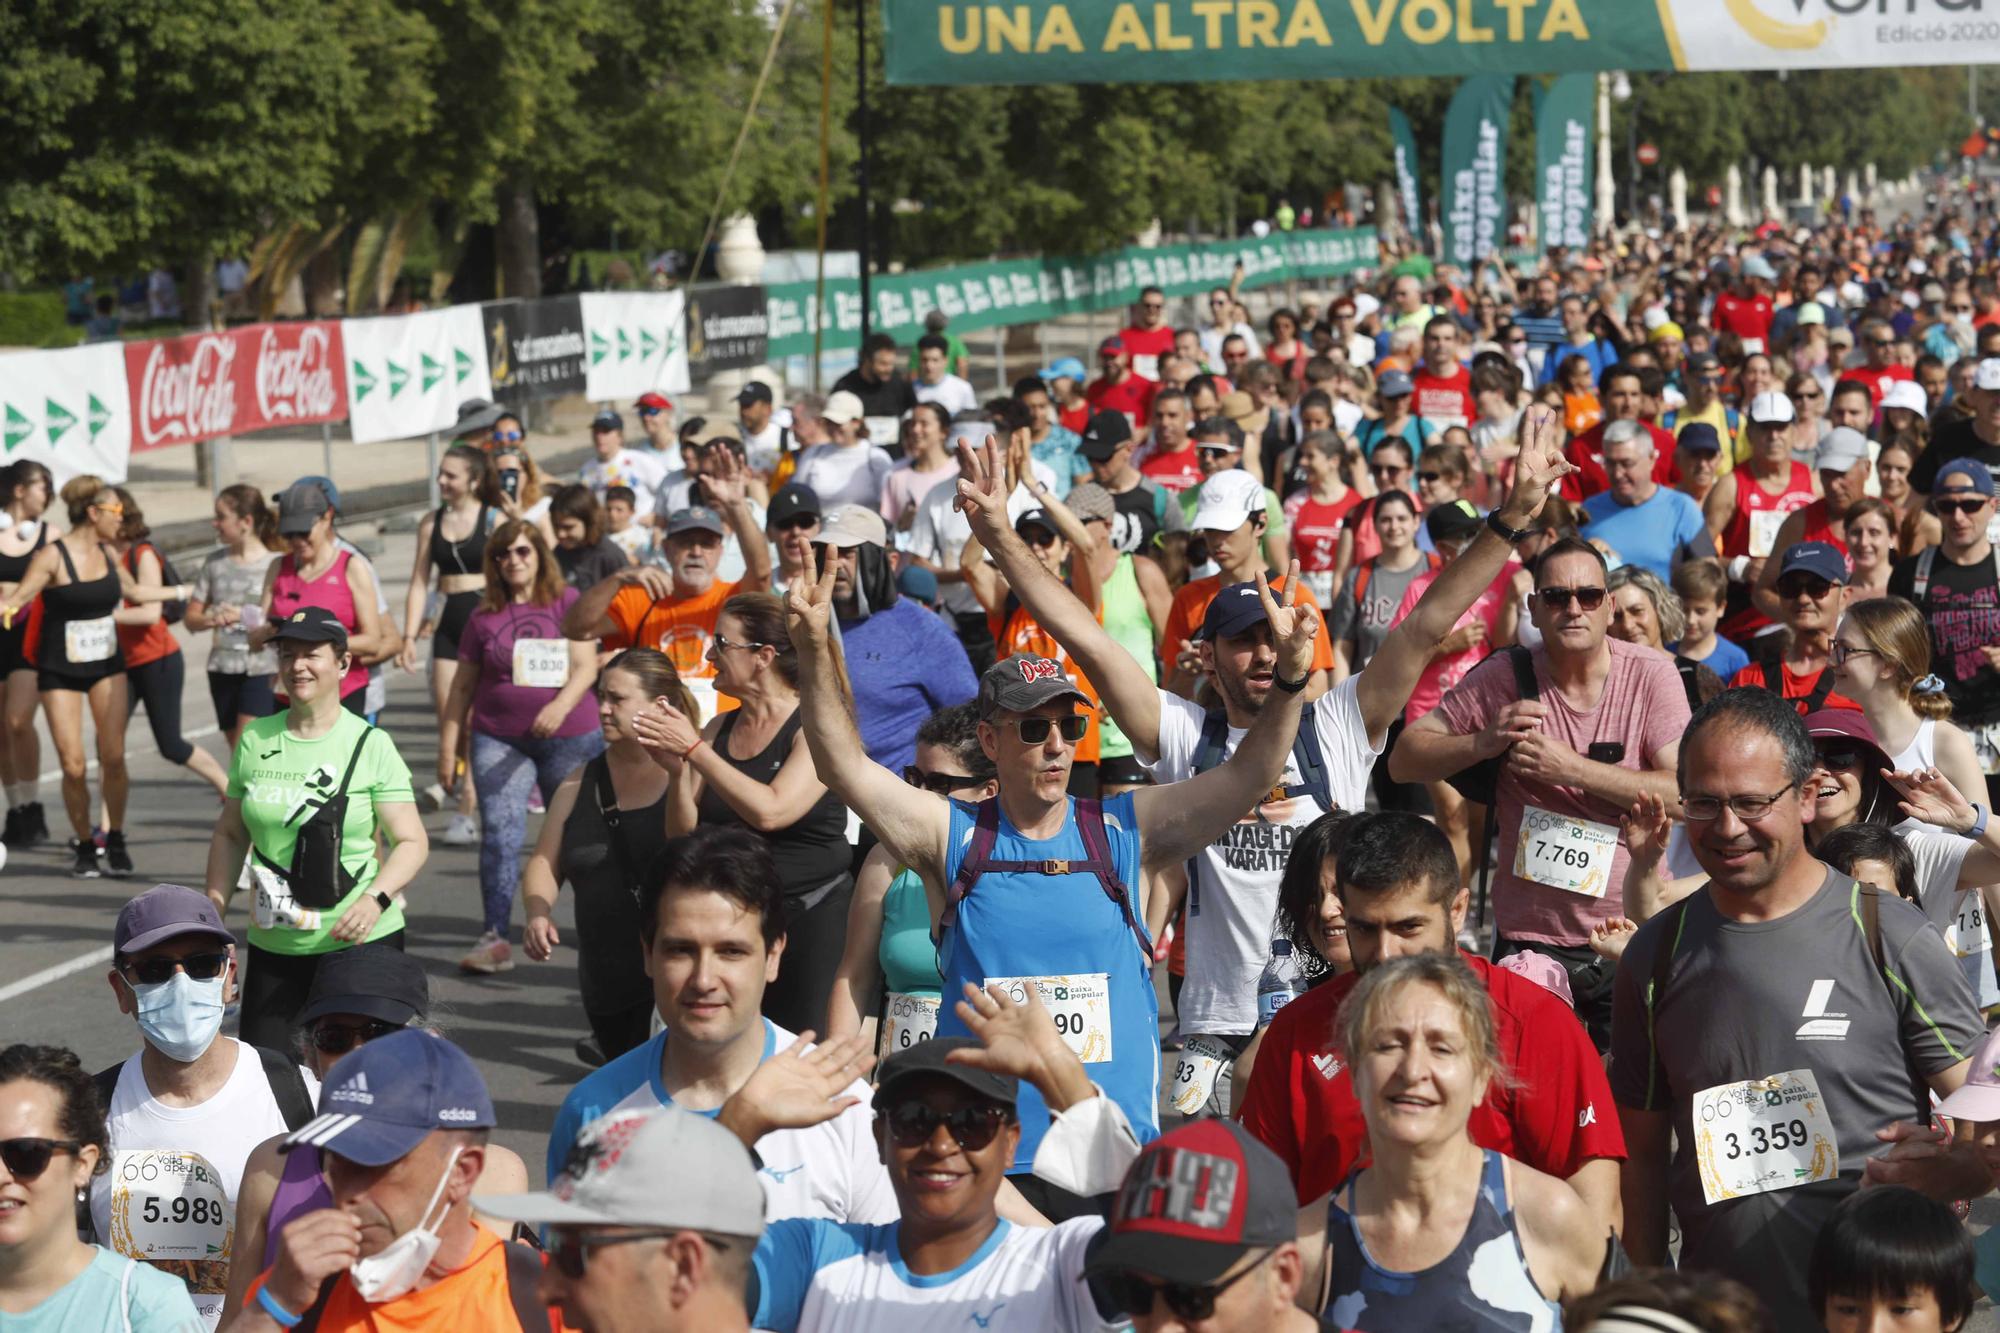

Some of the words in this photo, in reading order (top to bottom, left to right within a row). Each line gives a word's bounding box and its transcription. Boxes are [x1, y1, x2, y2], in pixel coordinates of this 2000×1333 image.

[938, 4, 1084, 54] UNA
[1102, 0, 1333, 53] ALTRA
[1350, 0, 1590, 46] VOLTA
[1876, 23, 1946, 43] Edició
[1560, 118, 1588, 247] popular
[1449, 169, 1474, 262] caixa
[1541, 164, 1563, 247] caixa
[251, 768, 308, 782] runners
[1528, 810, 1550, 831] 66
[1535, 840, 1590, 869] 7.769
[1070, 992, 1105, 1000] popular
[893, 996, 912, 1018] 66
[1198, 1041, 1218, 1055] caixa
[331, 1090, 374, 1105] adidas
[1782, 1085, 1808, 1096] caixa
[1785, 1091, 1818, 1104] popular
[438, 1107, 477, 1121] adidas
[1701, 1090, 1732, 1122] 66
[1728, 1087, 1753, 1099] Volta
[1725, 1118, 1808, 1160] 3.359
[123, 1154, 158, 1181] 66
[157, 1154, 183, 1166] Volta
[172, 1163, 193, 1175] peu
[142, 1196, 223, 1226] 5.989
